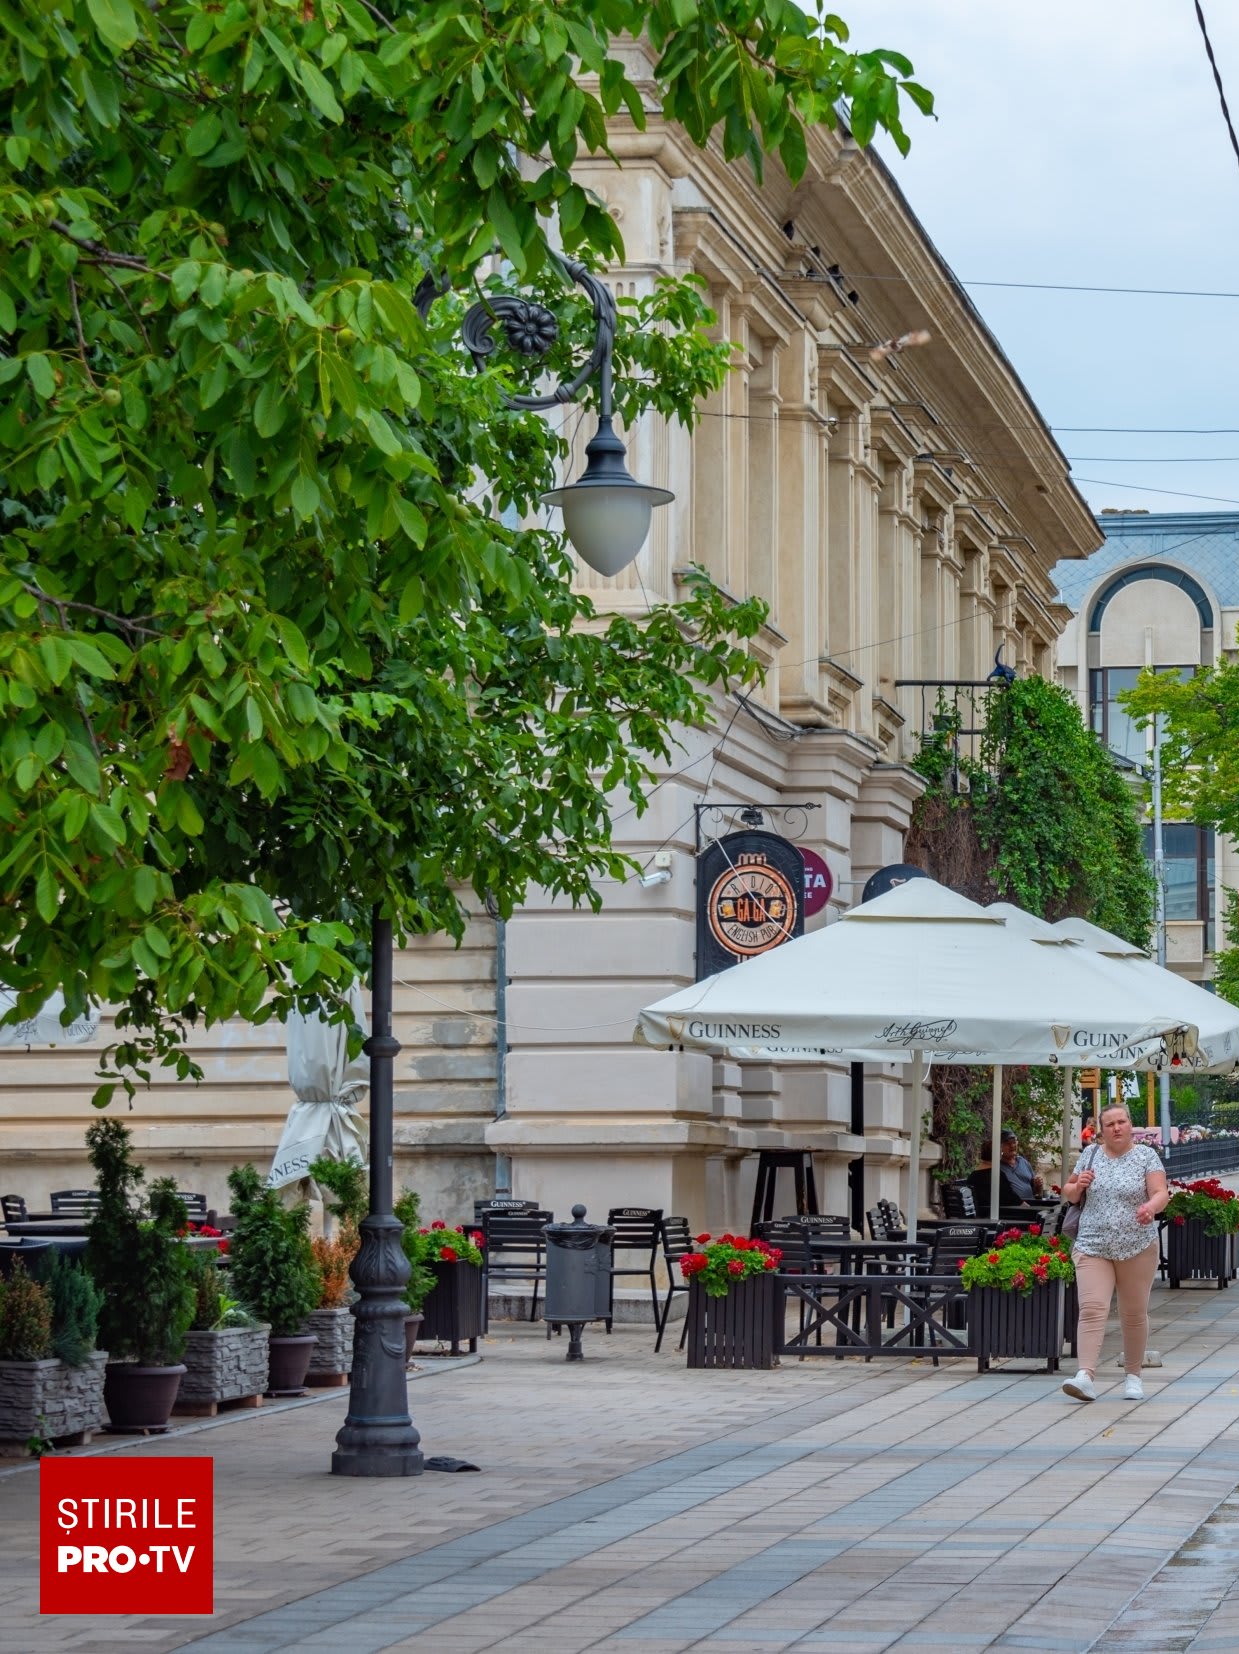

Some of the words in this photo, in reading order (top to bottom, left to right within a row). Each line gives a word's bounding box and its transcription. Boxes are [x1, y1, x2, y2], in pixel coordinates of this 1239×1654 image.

[737, 898, 750, 921] GA
[727, 923, 758, 943] ENGLISH
[760, 924, 777, 941] PUB
[688, 1021, 781, 1039] GUINNESS
[490, 1200, 523, 1208] GUINNESS
[800, 1216, 834, 1224] GUINNESS
